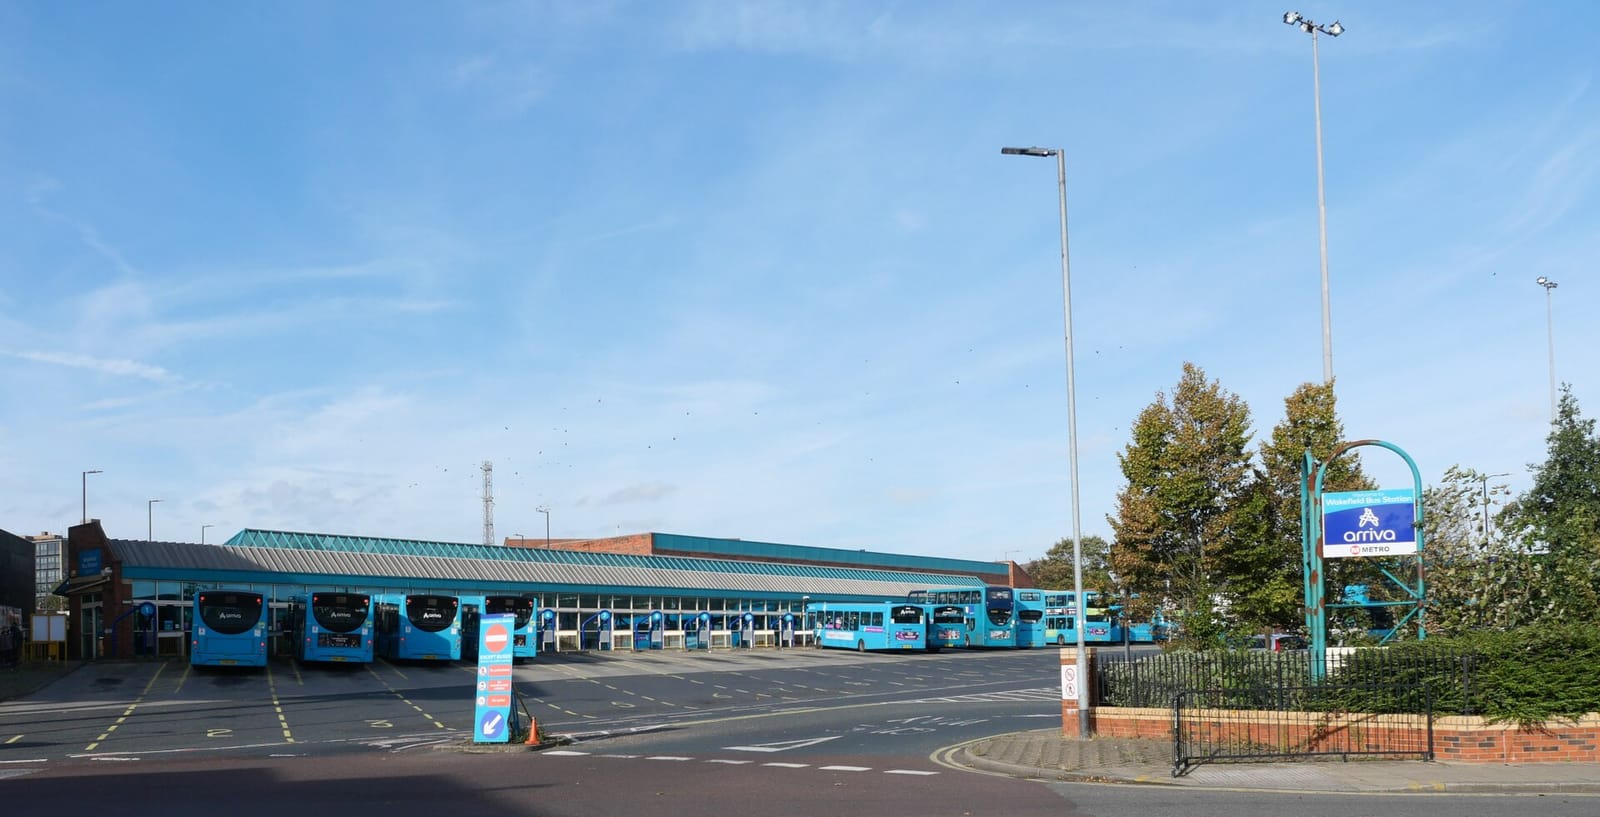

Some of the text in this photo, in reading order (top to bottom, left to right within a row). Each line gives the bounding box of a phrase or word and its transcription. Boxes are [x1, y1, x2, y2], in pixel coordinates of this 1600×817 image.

[1366, 496, 1381, 504] Bus
[1382, 495, 1412, 503] Station
[1343, 527, 1396, 542] arriva
[207, 728, 233, 738] 2
